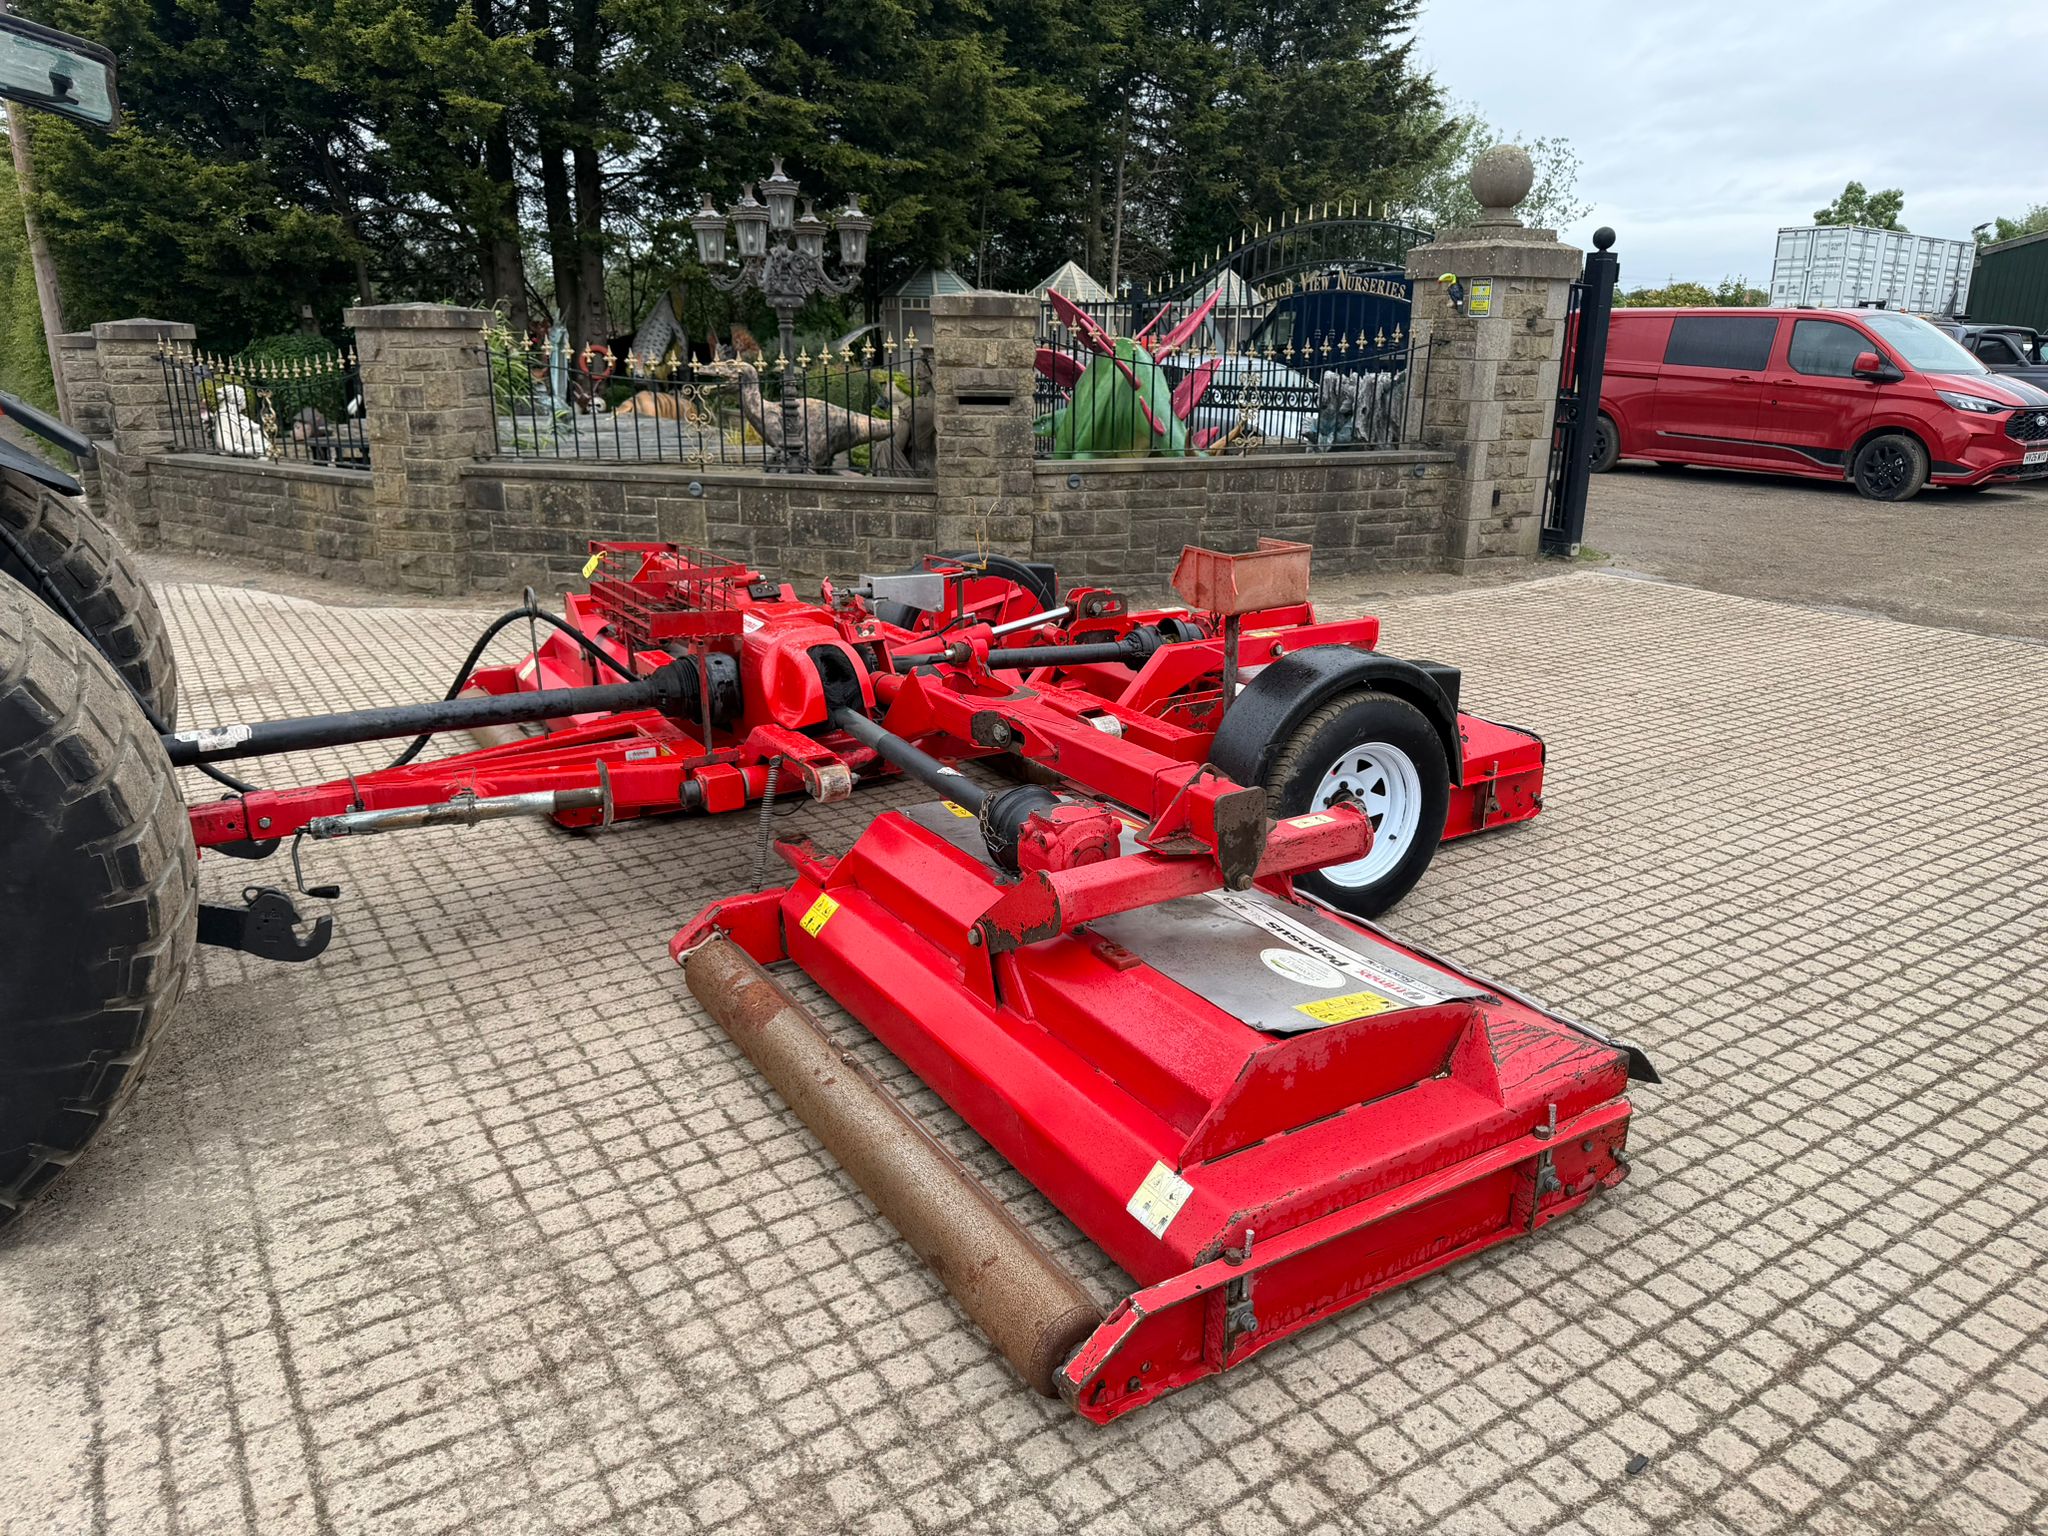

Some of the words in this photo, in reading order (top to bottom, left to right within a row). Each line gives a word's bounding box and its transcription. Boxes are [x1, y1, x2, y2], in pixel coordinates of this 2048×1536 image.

[1300, 270, 1330, 292] VIEW
[1336, 270, 1406, 299] NURSERIES
[1265, 921, 1350, 967] Pegasus
